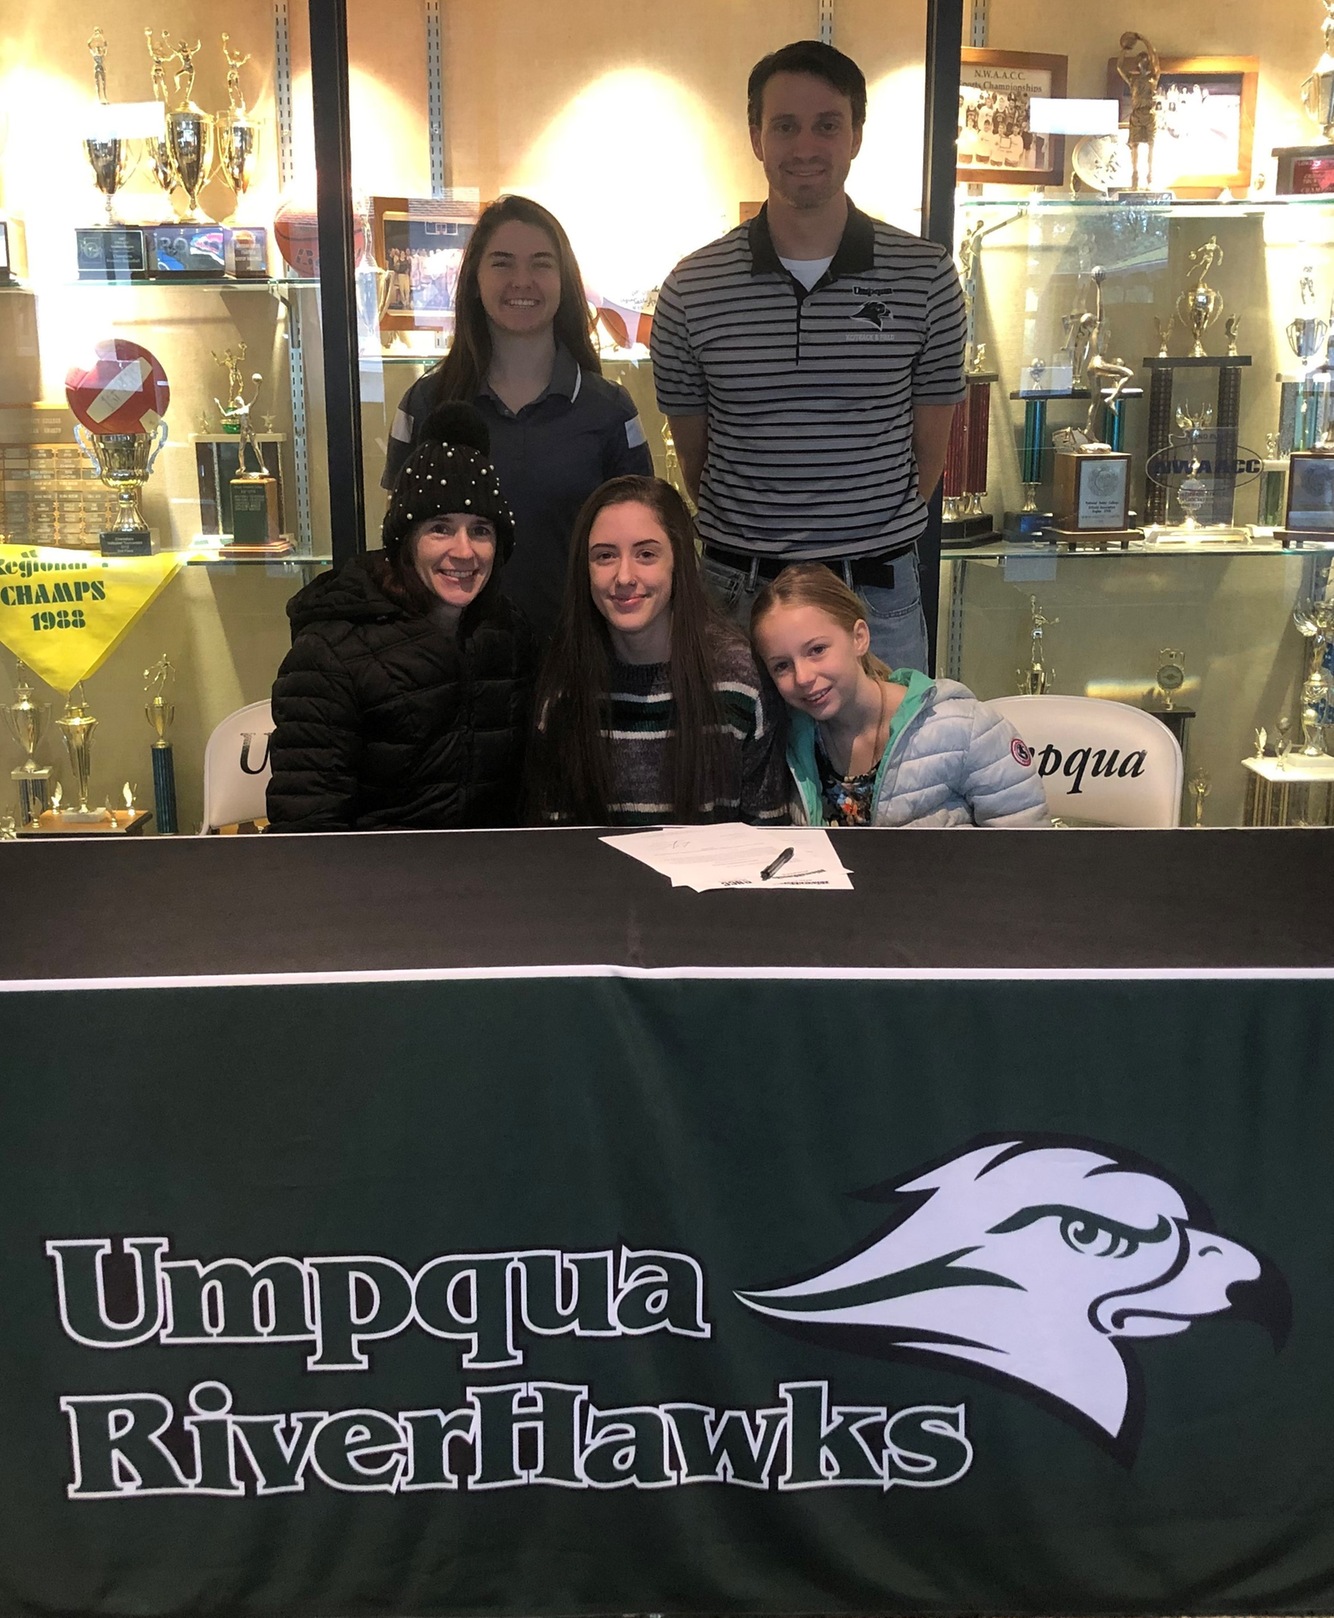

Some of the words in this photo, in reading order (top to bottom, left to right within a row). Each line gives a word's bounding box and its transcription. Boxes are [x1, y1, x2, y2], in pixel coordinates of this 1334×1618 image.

[974, 69, 1026, 81] N.W.A.A.C.C.
[983, 81, 1043, 94] Championships
[852, 285, 893, 297] Umpqua
[1153, 459, 1261, 474] NWAACC
[1, 581, 106, 606] CHAMPS
[31, 609, 86, 631] 1988
[1029, 744, 1148, 794] pqua
[46, 1237, 711, 1370] Umpqua
[59, 1380, 974, 1499] RiverHawks
